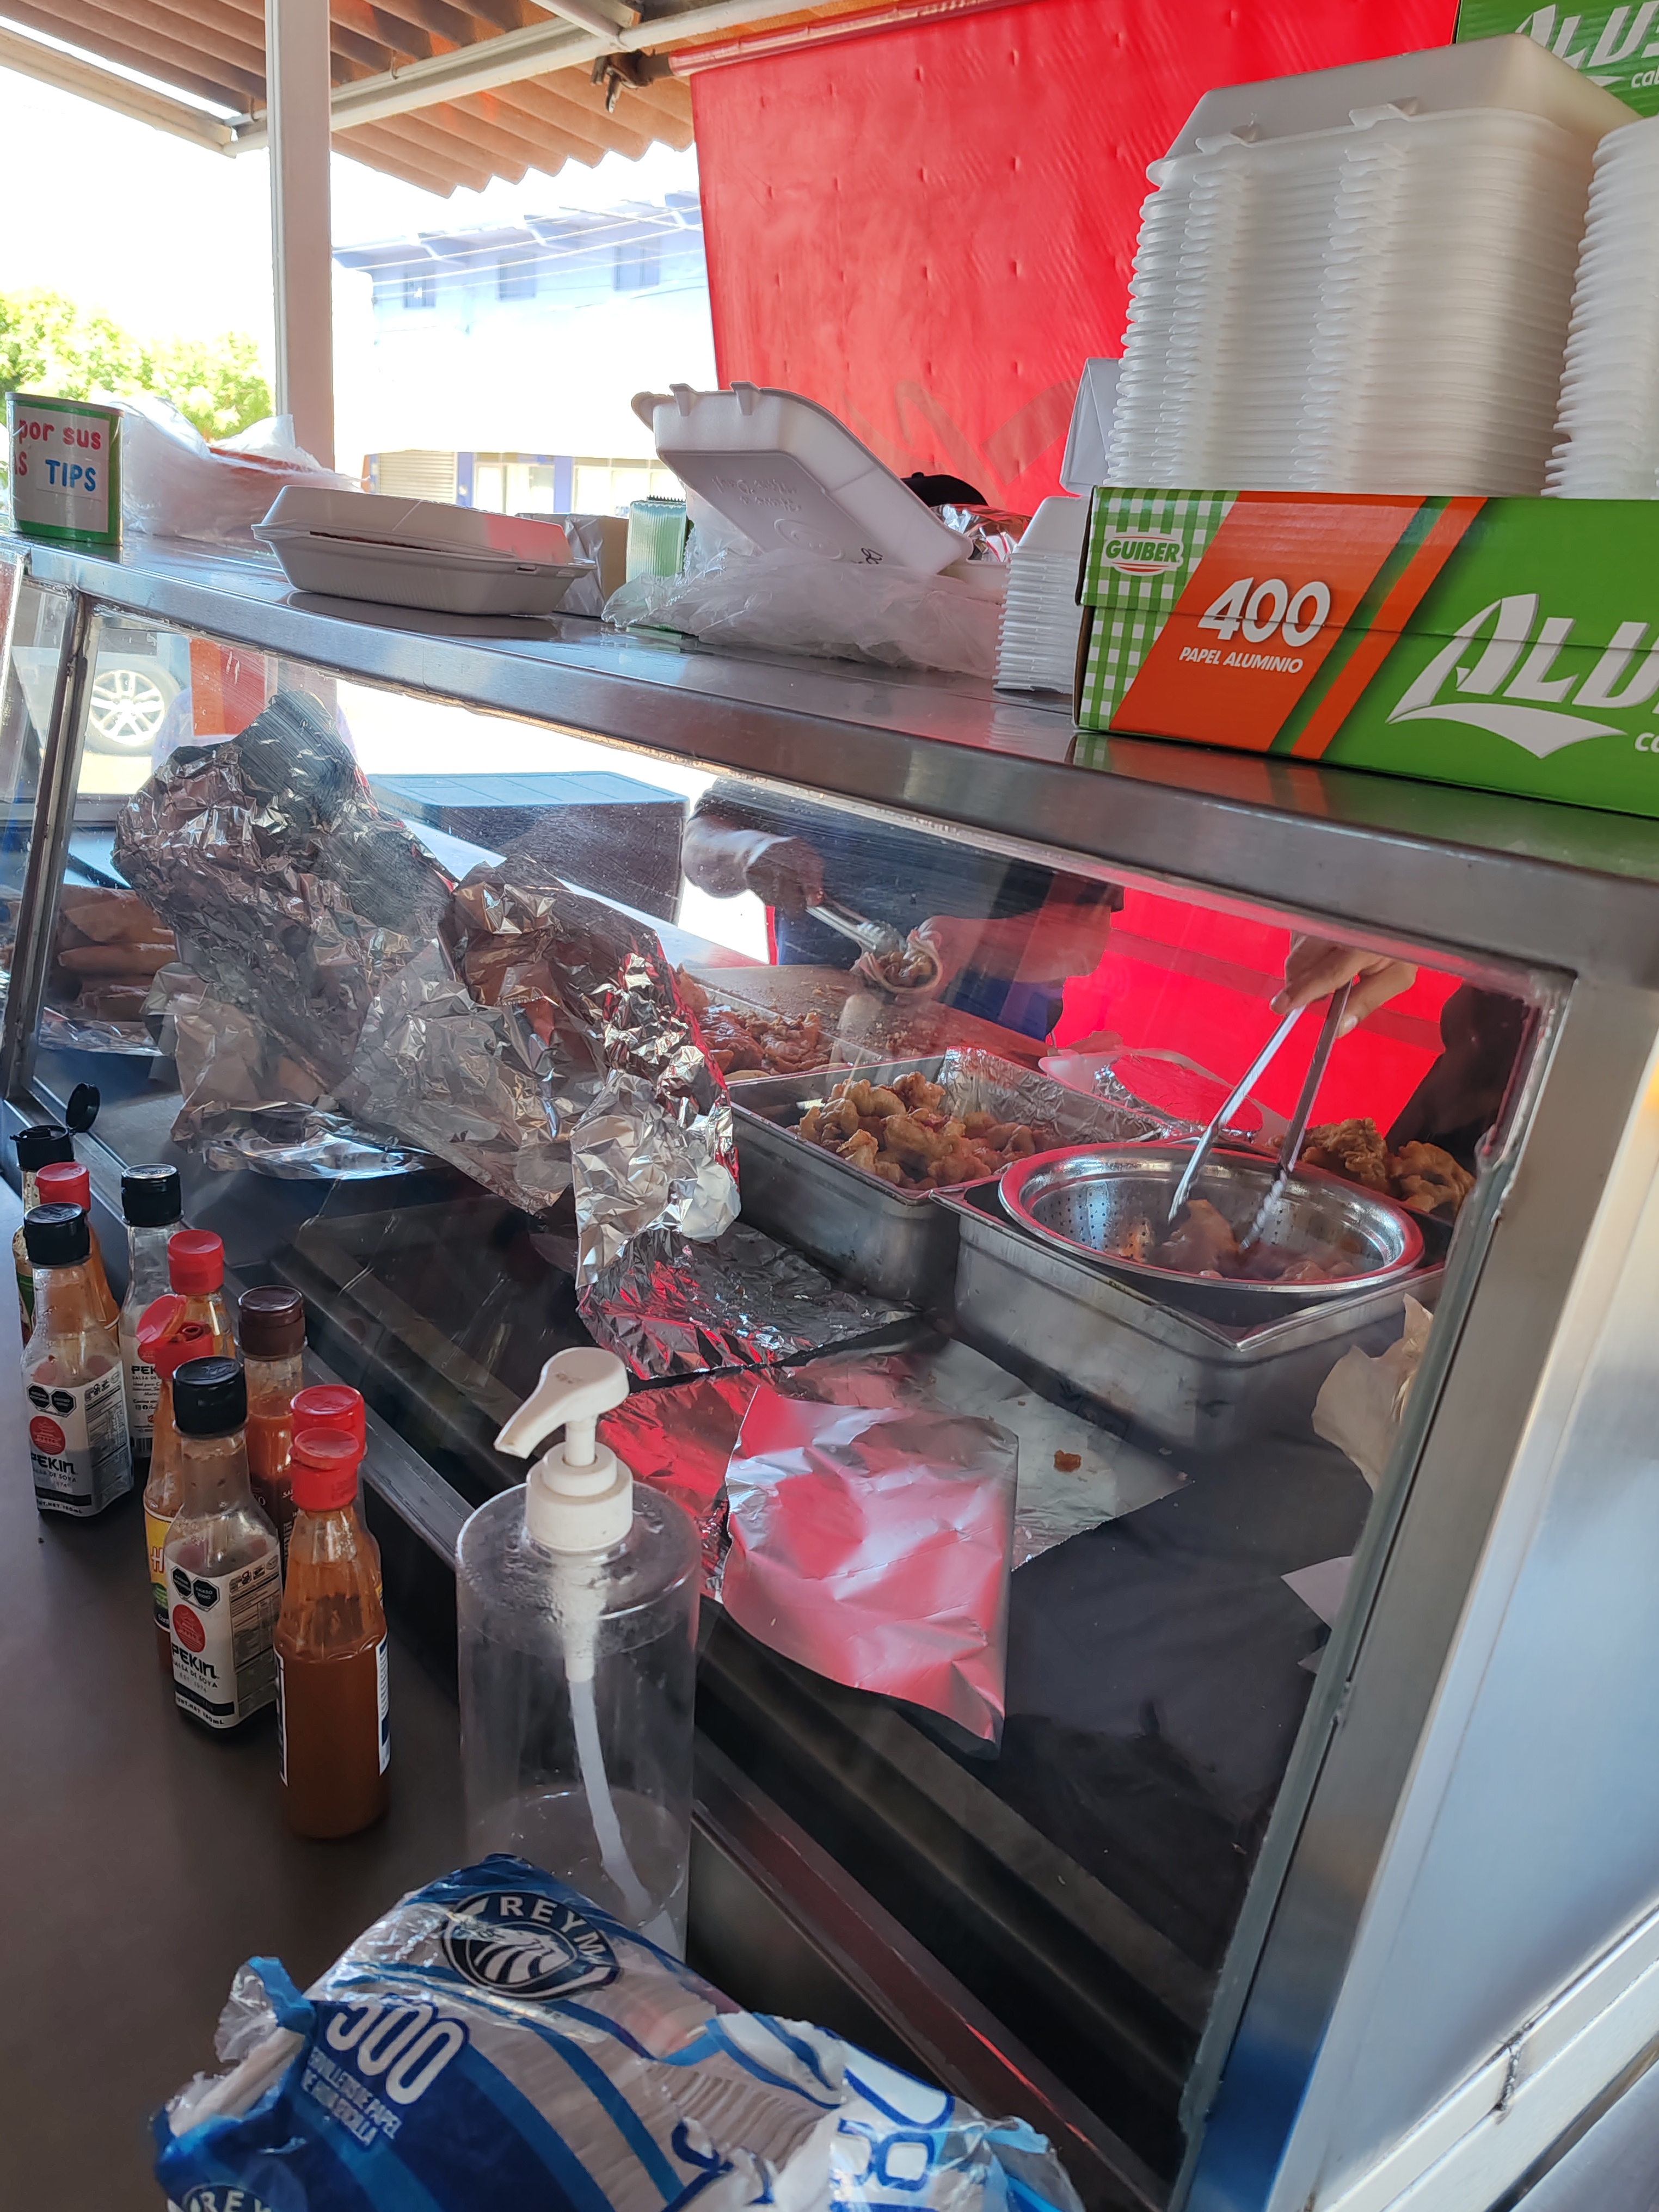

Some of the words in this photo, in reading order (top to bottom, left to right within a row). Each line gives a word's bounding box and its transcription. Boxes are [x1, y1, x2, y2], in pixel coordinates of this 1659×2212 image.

[19, 419, 54, 444] por
[63, 427, 101, 450] sus
[45, 459, 96, 491] TIPS
[1105, 539, 1181, 563] GUIBER
[1198, 577, 1331, 647] 400
[1179, 647, 1222, 665] PAPEL
[1222, 652, 1304, 674] ALUMINIO
[1385, 593, 1659, 723] ALU
